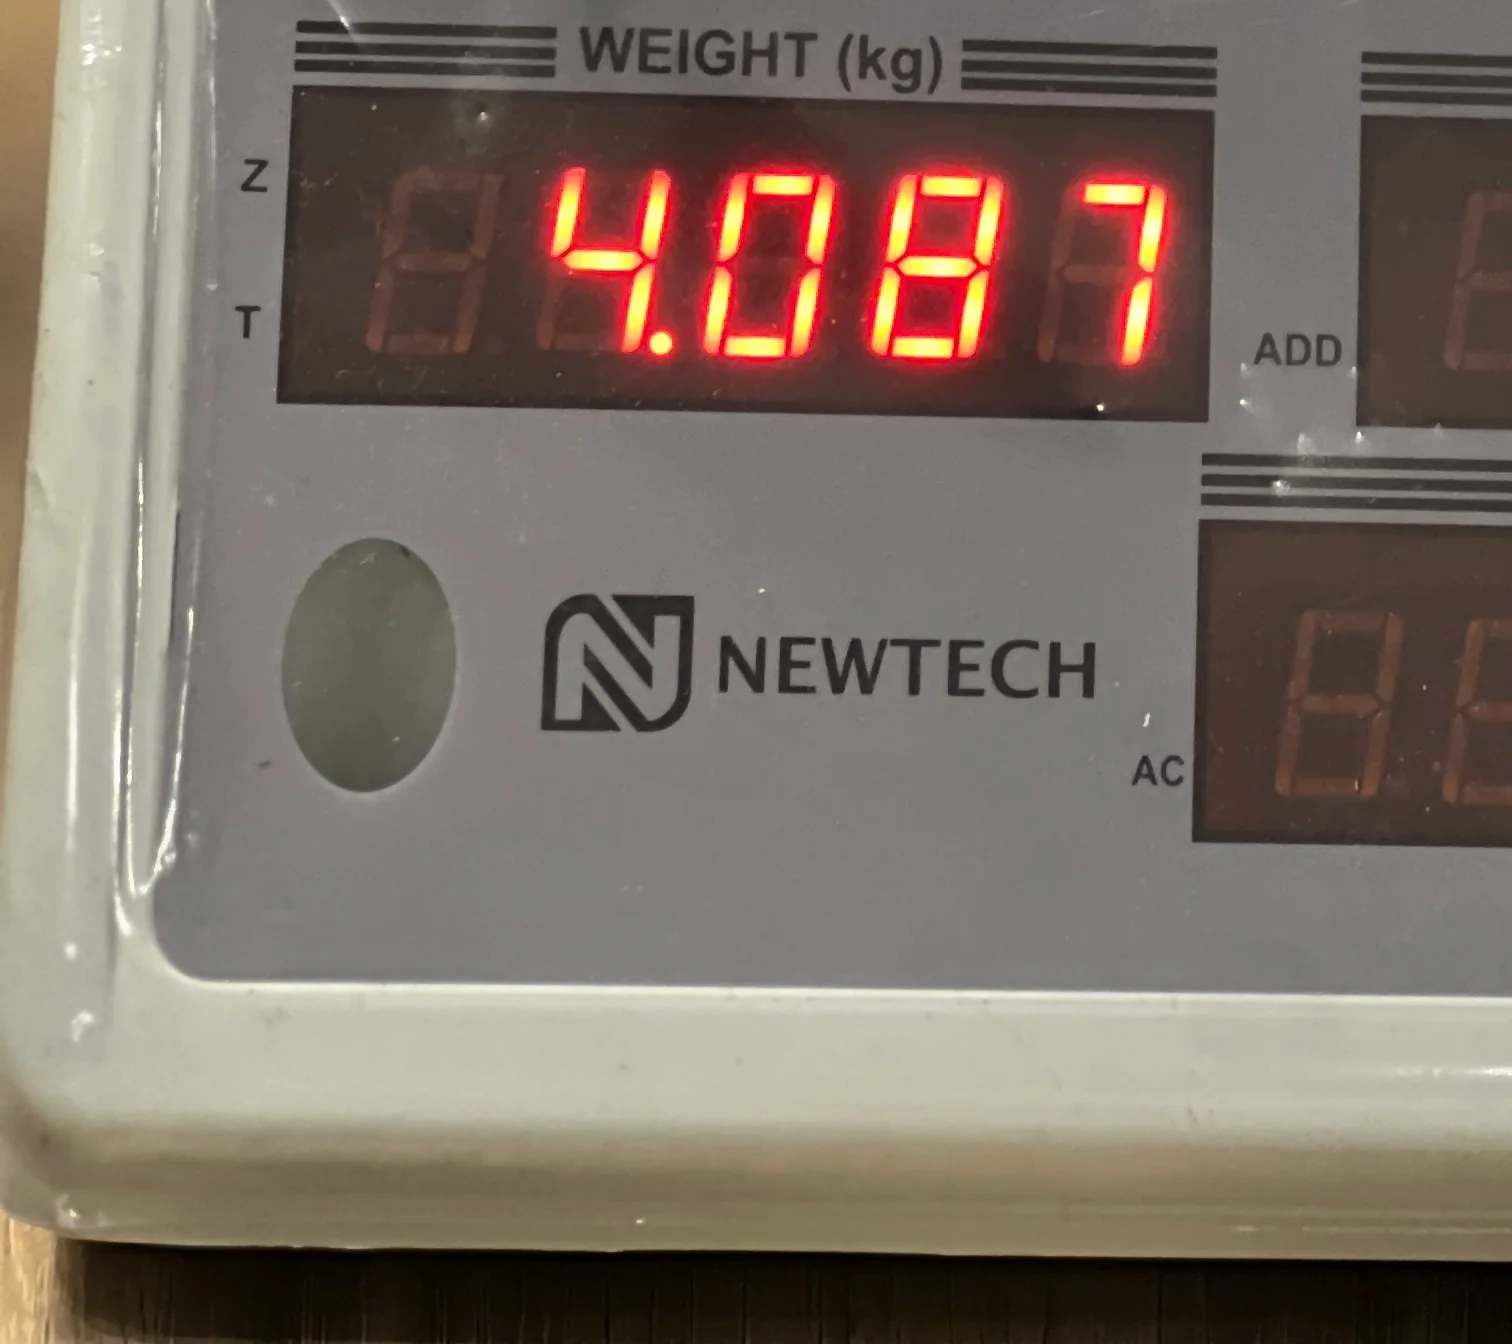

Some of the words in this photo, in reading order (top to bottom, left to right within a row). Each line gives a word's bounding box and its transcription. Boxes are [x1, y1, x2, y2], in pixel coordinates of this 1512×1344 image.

[580, 27, 817, 80] WEIGHT
[838, 34, 943, 93] (kg)
[240, 159, 268, 193] Z
[550, 166, 1167, 365] 4.087
[234, 305, 262, 339] T
[1254, 332, 1343, 367] ADD
[718, 635, 1097, 699] NEWTECH
[1132, 755, 1184, 787] AC
